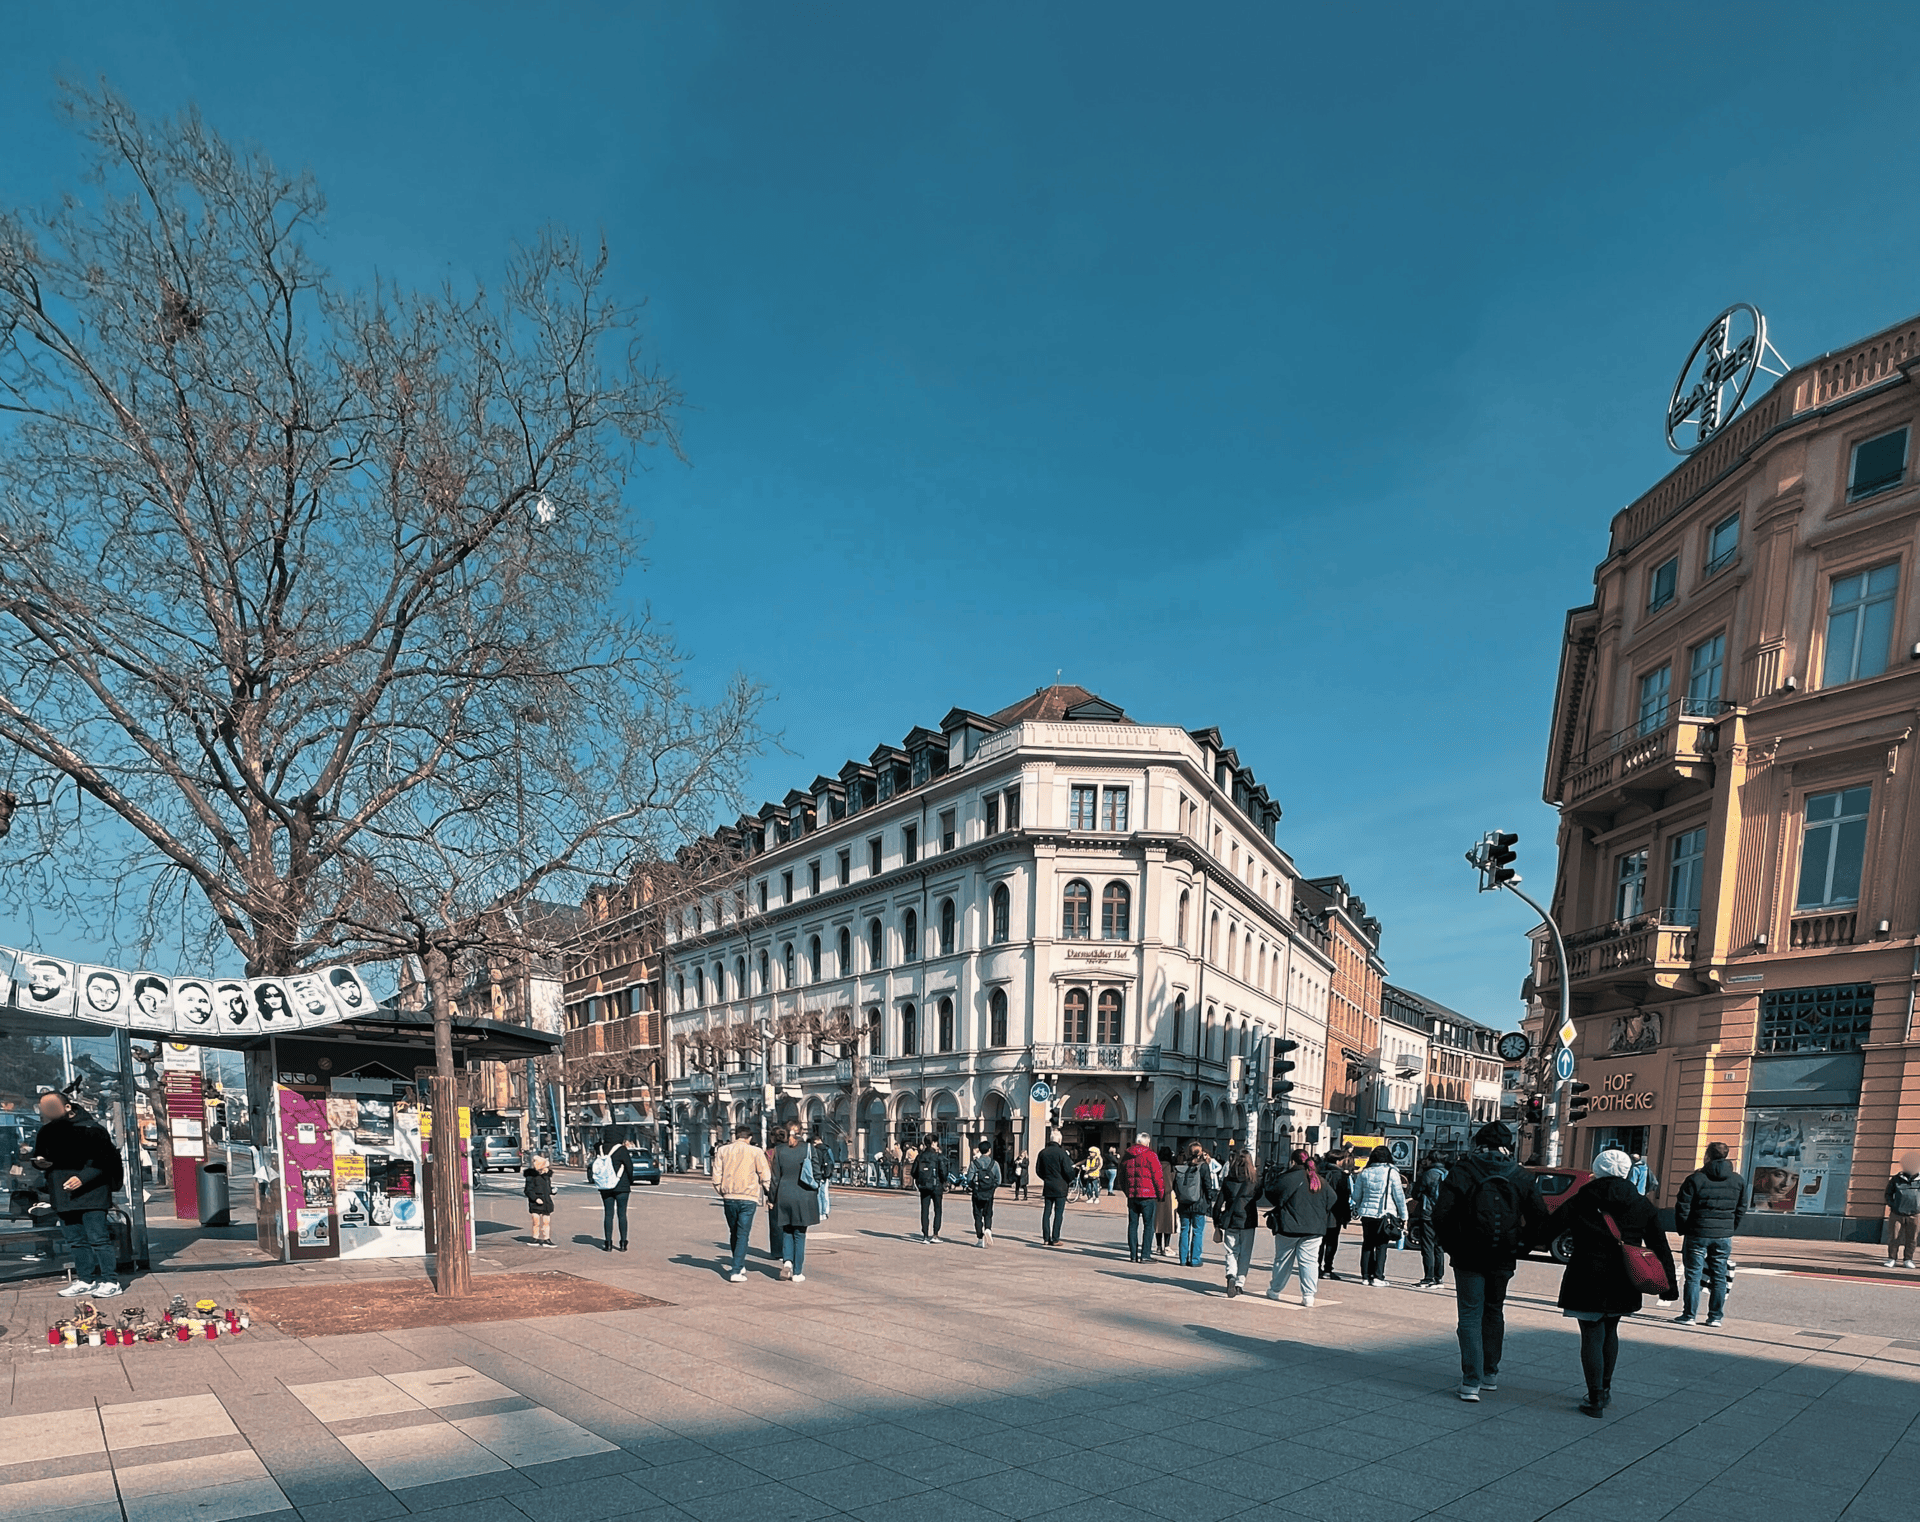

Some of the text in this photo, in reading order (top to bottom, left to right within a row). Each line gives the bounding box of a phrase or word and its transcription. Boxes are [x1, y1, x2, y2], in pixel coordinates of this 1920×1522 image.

[1671, 335, 1755, 428] BAYER
[1697, 322, 1726, 442] BAYER
[1603, 1073, 1633, 1091] HOF
